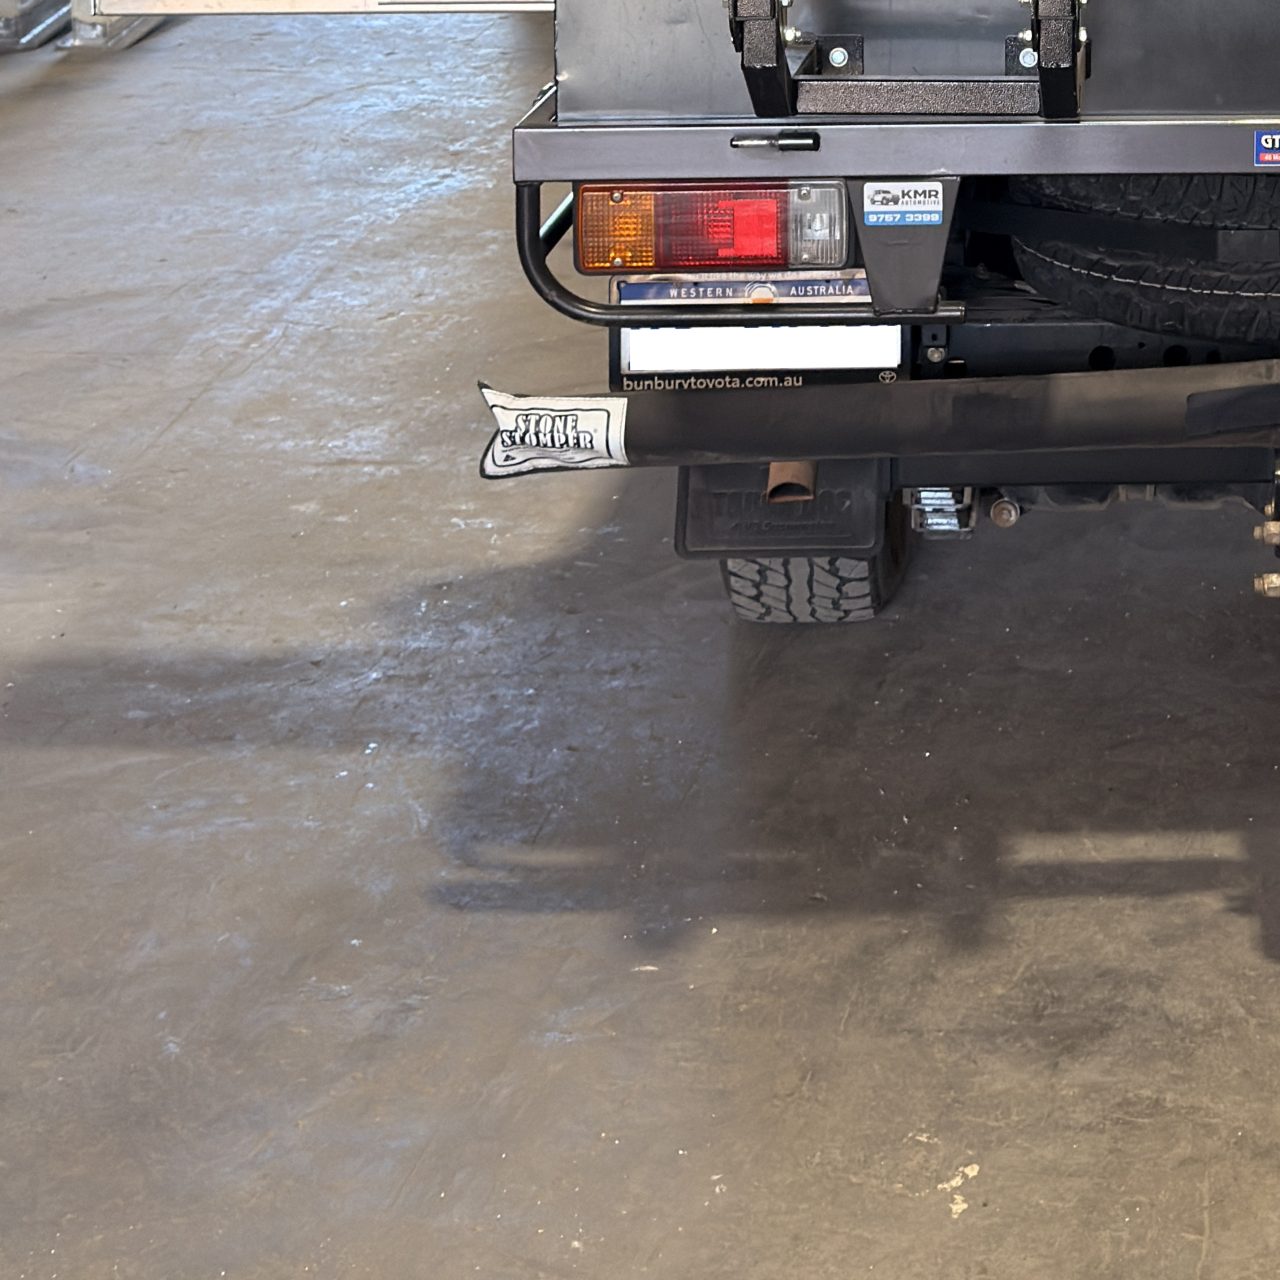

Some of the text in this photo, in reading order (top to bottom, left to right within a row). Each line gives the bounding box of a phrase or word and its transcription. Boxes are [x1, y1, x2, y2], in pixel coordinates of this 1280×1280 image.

[901, 189, 939, 199] KMR
[747, 271, 766, 282] way
[669, 284, 854, 298] WESTERN AUSTRALIA
[515, 413, 578, 434] STONE
[501, 429, 594, 449] STOMPER
